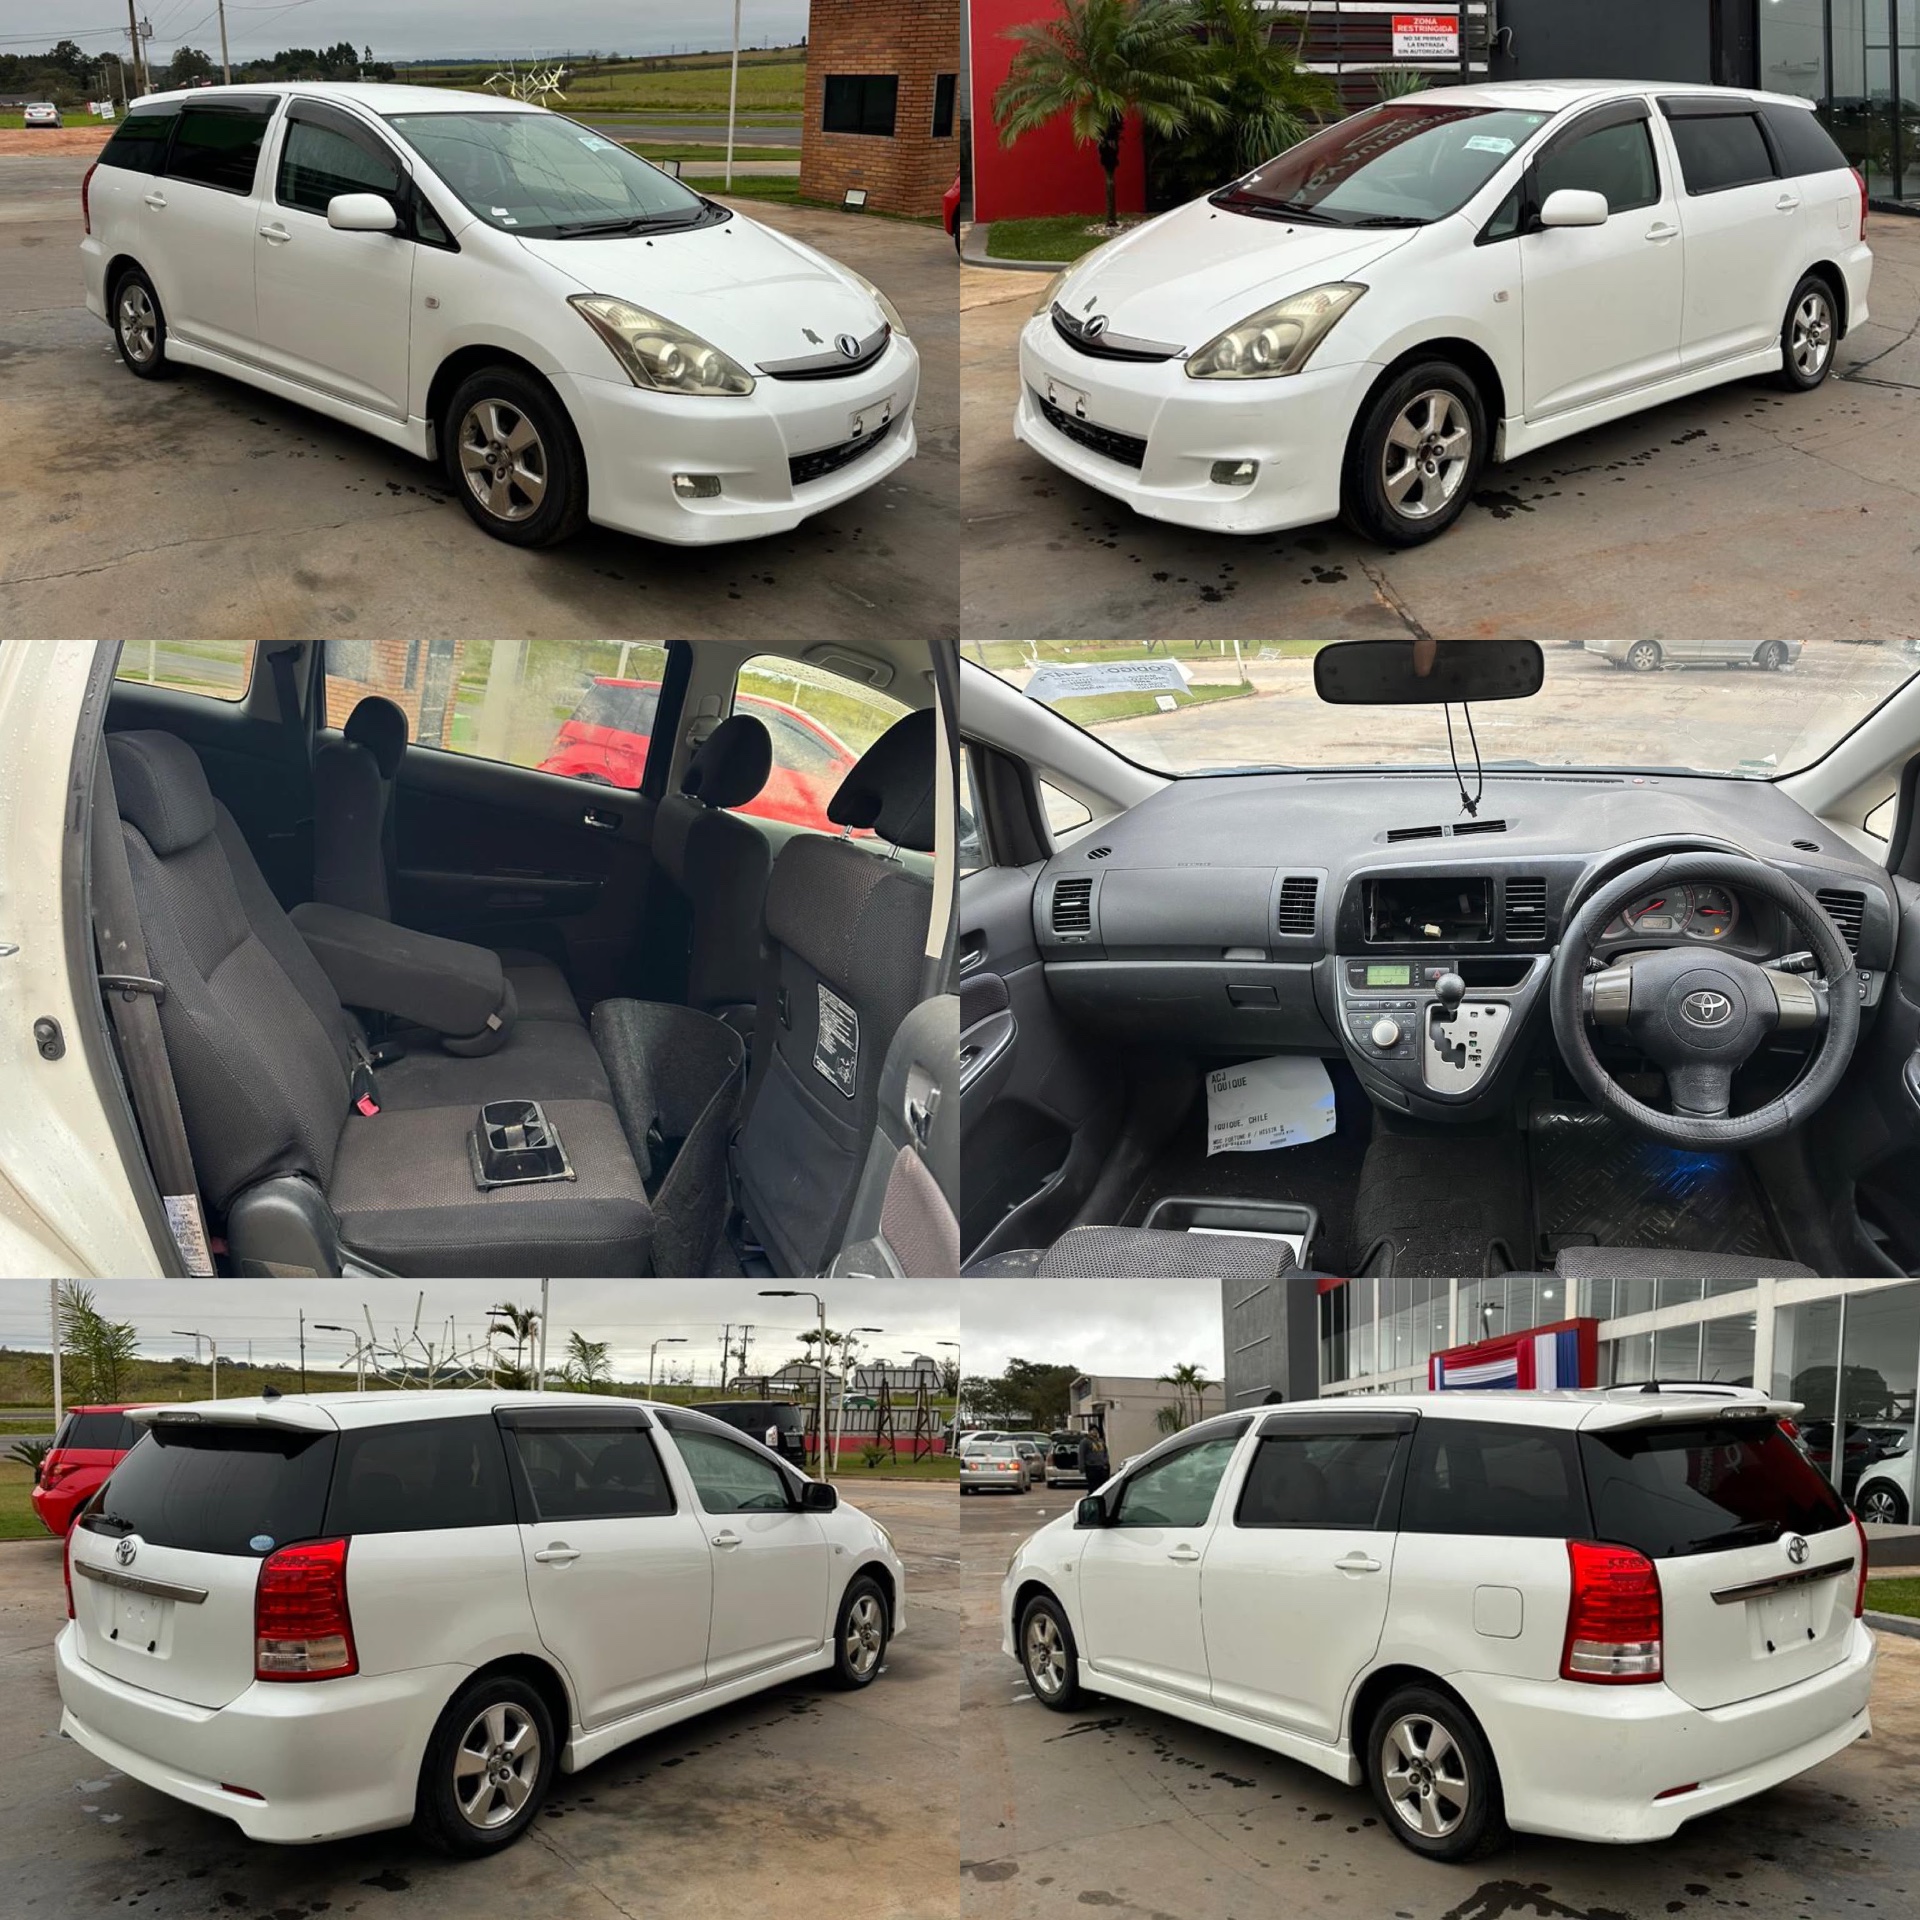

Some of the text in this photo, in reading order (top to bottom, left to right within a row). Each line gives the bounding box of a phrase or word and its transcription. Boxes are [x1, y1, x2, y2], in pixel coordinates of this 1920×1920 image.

[1211, 1072, 1227, 1084] ACJ
[1213, 1076, 1248, 1093] IQUIQUE
[1248, 1113, 1268, 1124] CHILE
[1224, 1133, 1246, 1143] FORTUNE
